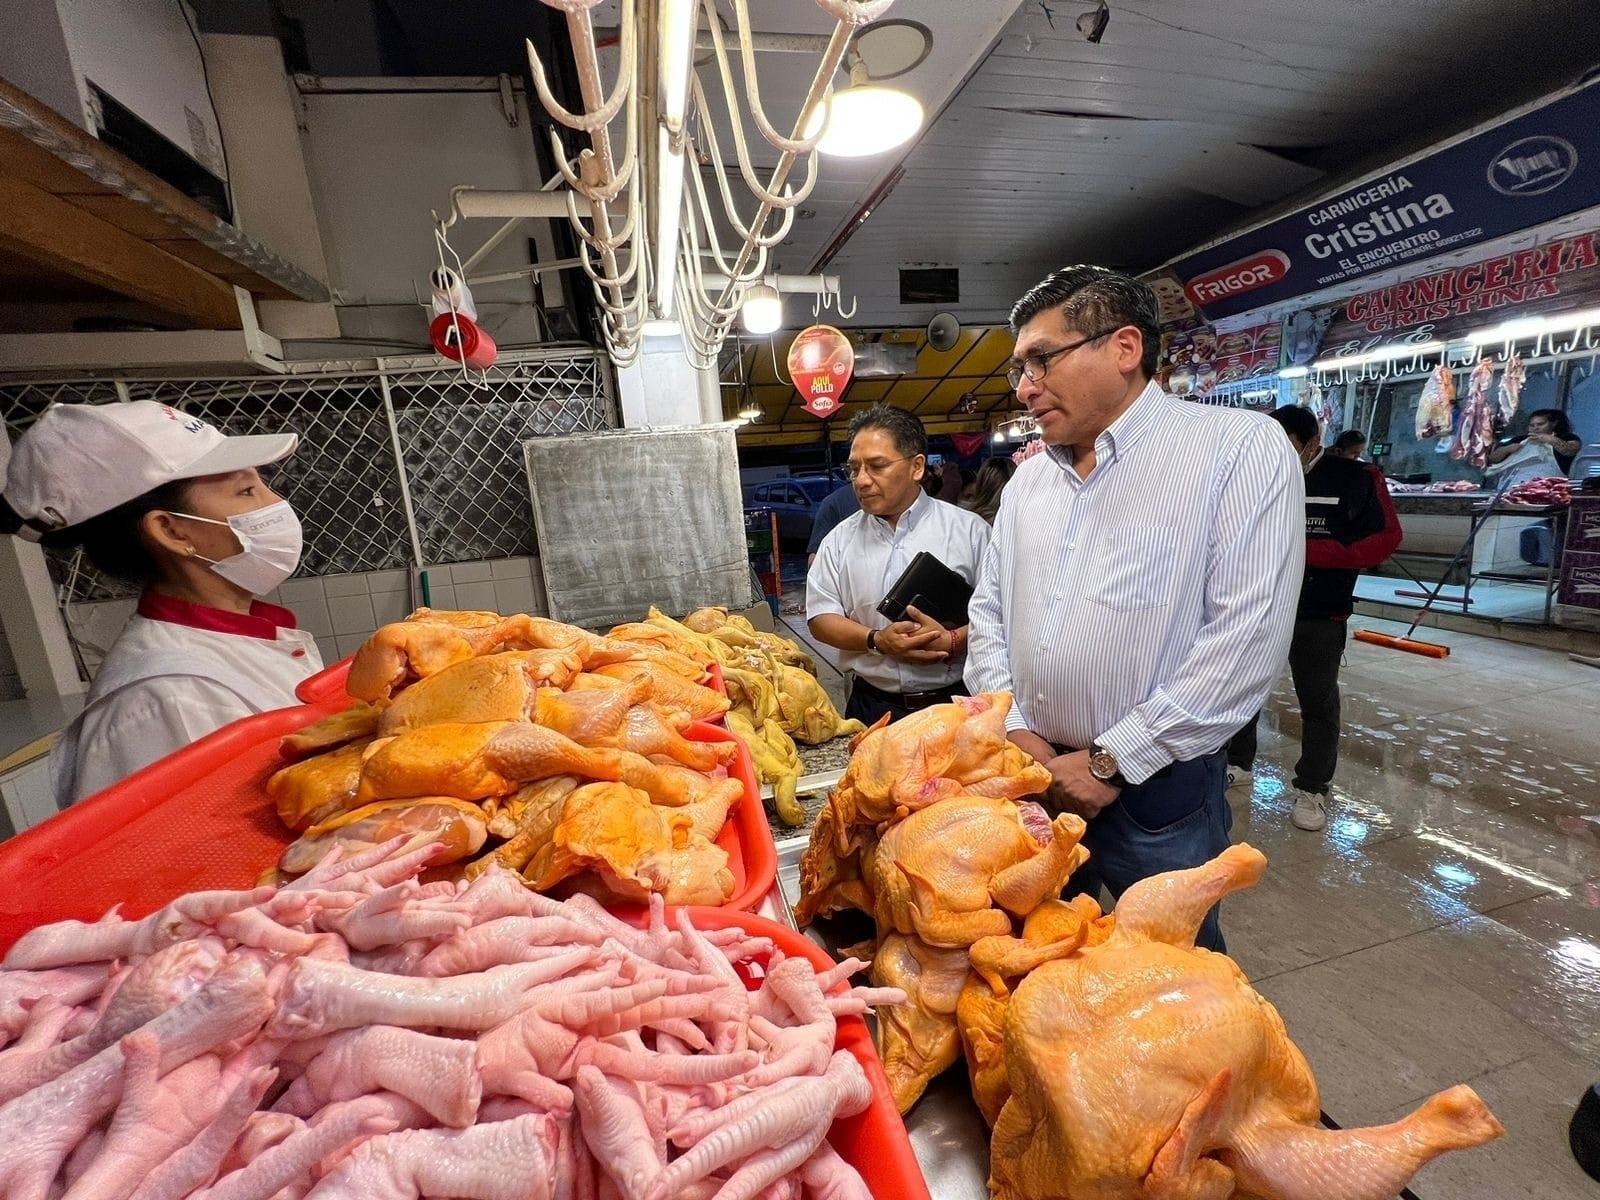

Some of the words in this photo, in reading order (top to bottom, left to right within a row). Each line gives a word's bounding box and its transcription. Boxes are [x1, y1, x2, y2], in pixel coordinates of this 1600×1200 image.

[1308, 175, 1413, 226] CARNICERÍA
[1304, 192, 1454, 260] Cristina
[1316, 272, 1345, 285] VENTAS
[1345, 265, 1362, 277] POR
[1363, 257, 1393, 271] MAYOR
[1338, 258, 1356, 271] EL
[1356, 229, 1441, 264] ENCUENTRO
[1193, 264, 1274, 301] FRIGOR
[1346, 233, 1598, 322] CARNICERIA
[1365, 277, 1561, 333] CRISTINA
[811, 383, 834, 395] POLLO
[1305, 517, 1326, 526] LIVIA
